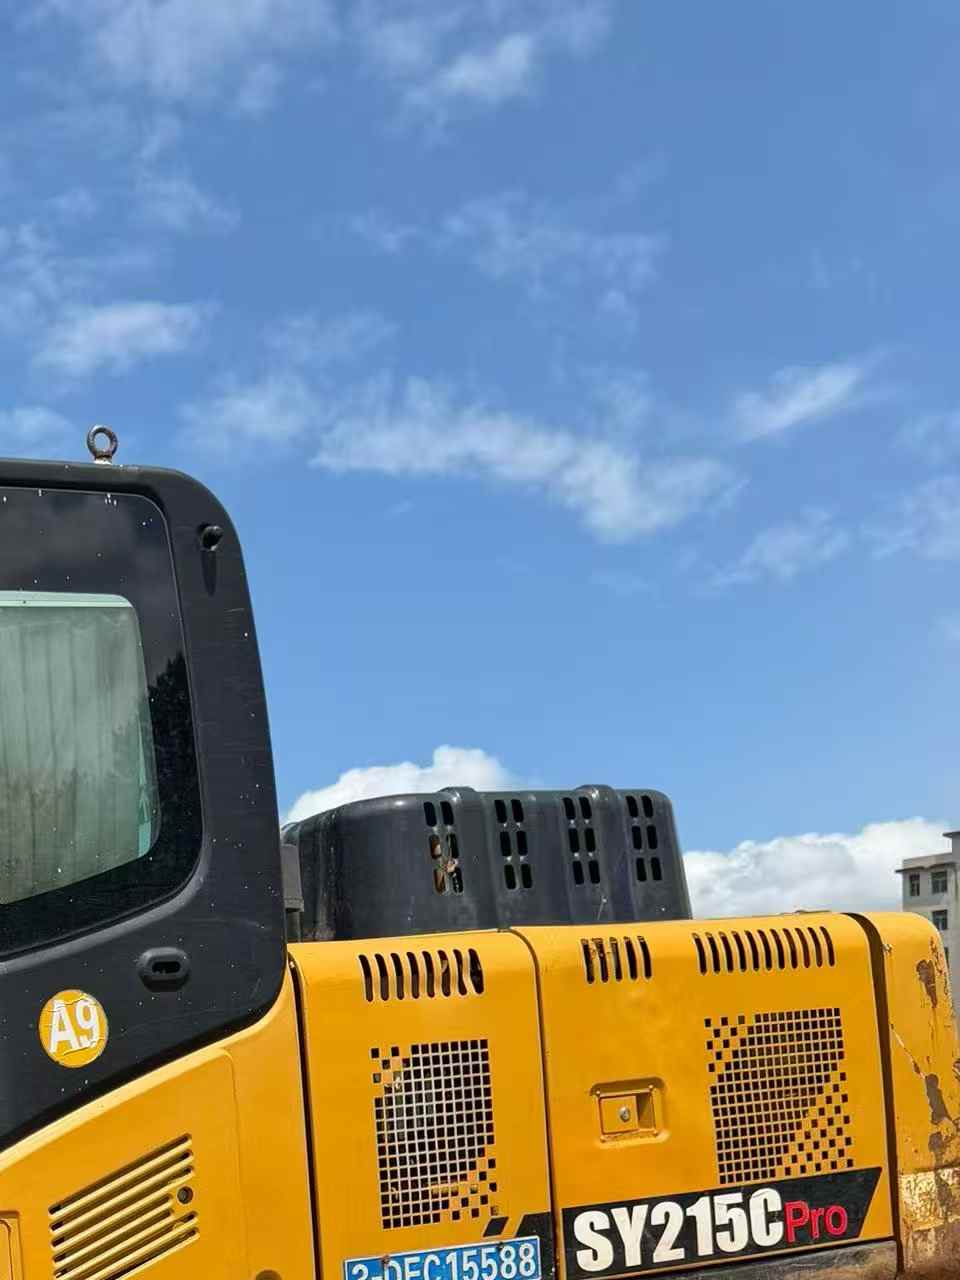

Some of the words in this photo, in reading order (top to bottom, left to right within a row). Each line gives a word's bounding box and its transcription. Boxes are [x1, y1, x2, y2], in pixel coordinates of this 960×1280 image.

[49, 999, 100, 1053] A9
[573, 1187, 784, 1273] SY215C
[784, 1200, 849, 1244] Pro
